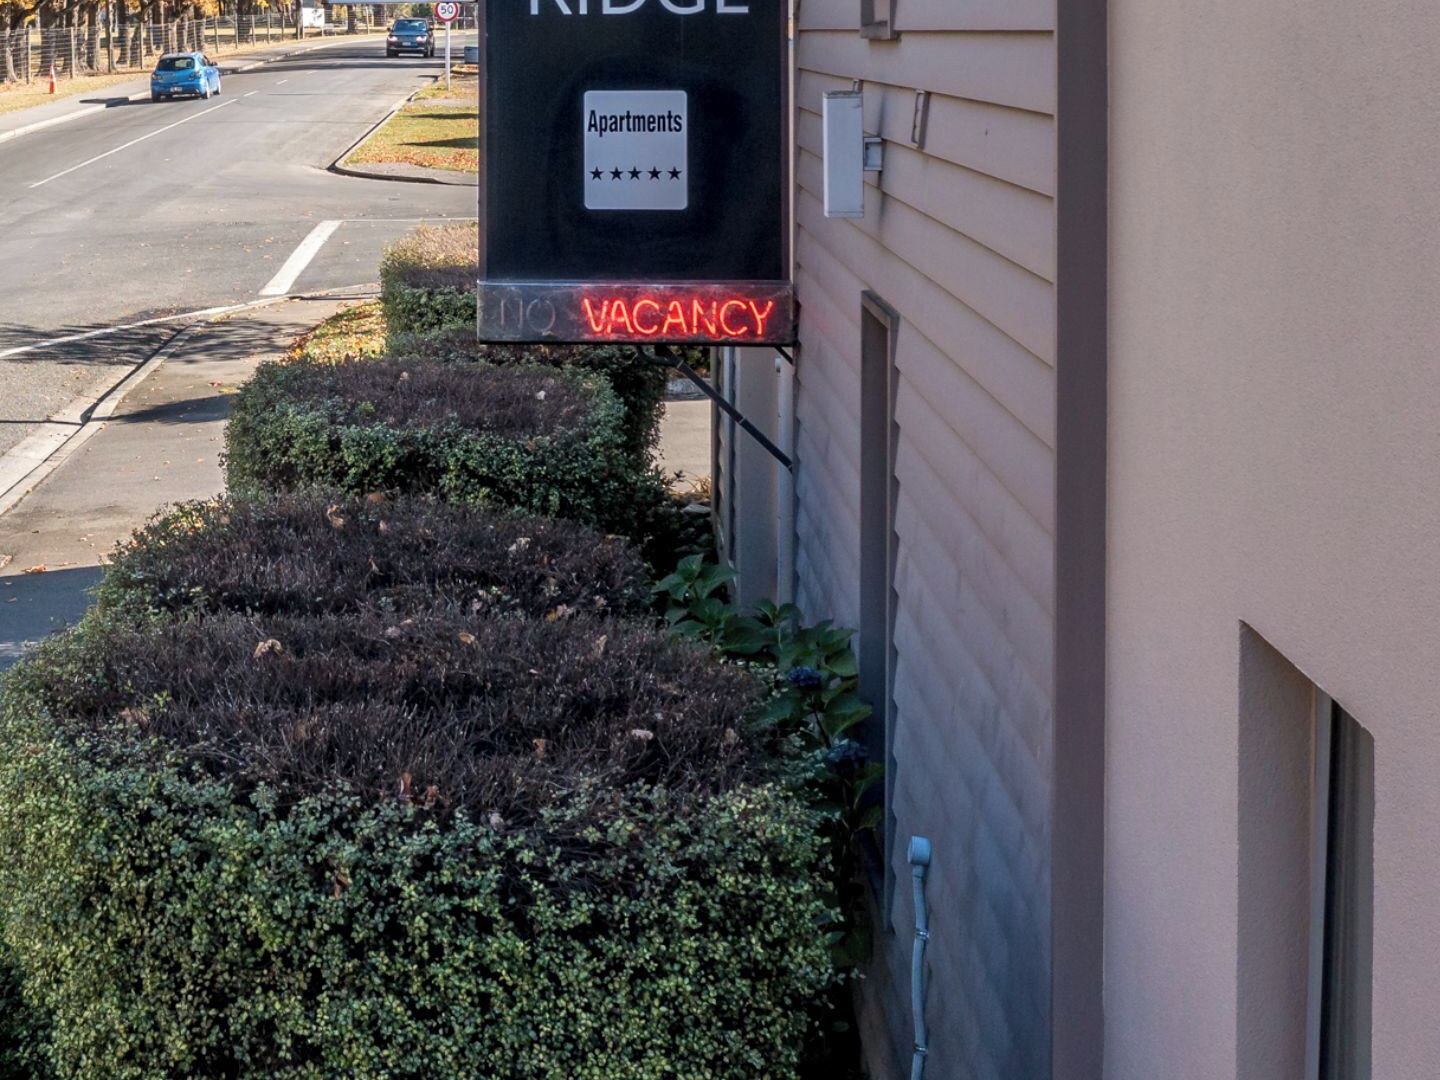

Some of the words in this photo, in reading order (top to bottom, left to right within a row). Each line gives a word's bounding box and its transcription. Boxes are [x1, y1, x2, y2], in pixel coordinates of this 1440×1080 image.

[441, 5, 453, 14] 50
[588, 109, 682, 137] Apartments
[500, 298, 556, 332] NO
[583, 298, 773, 335] VACANCY
